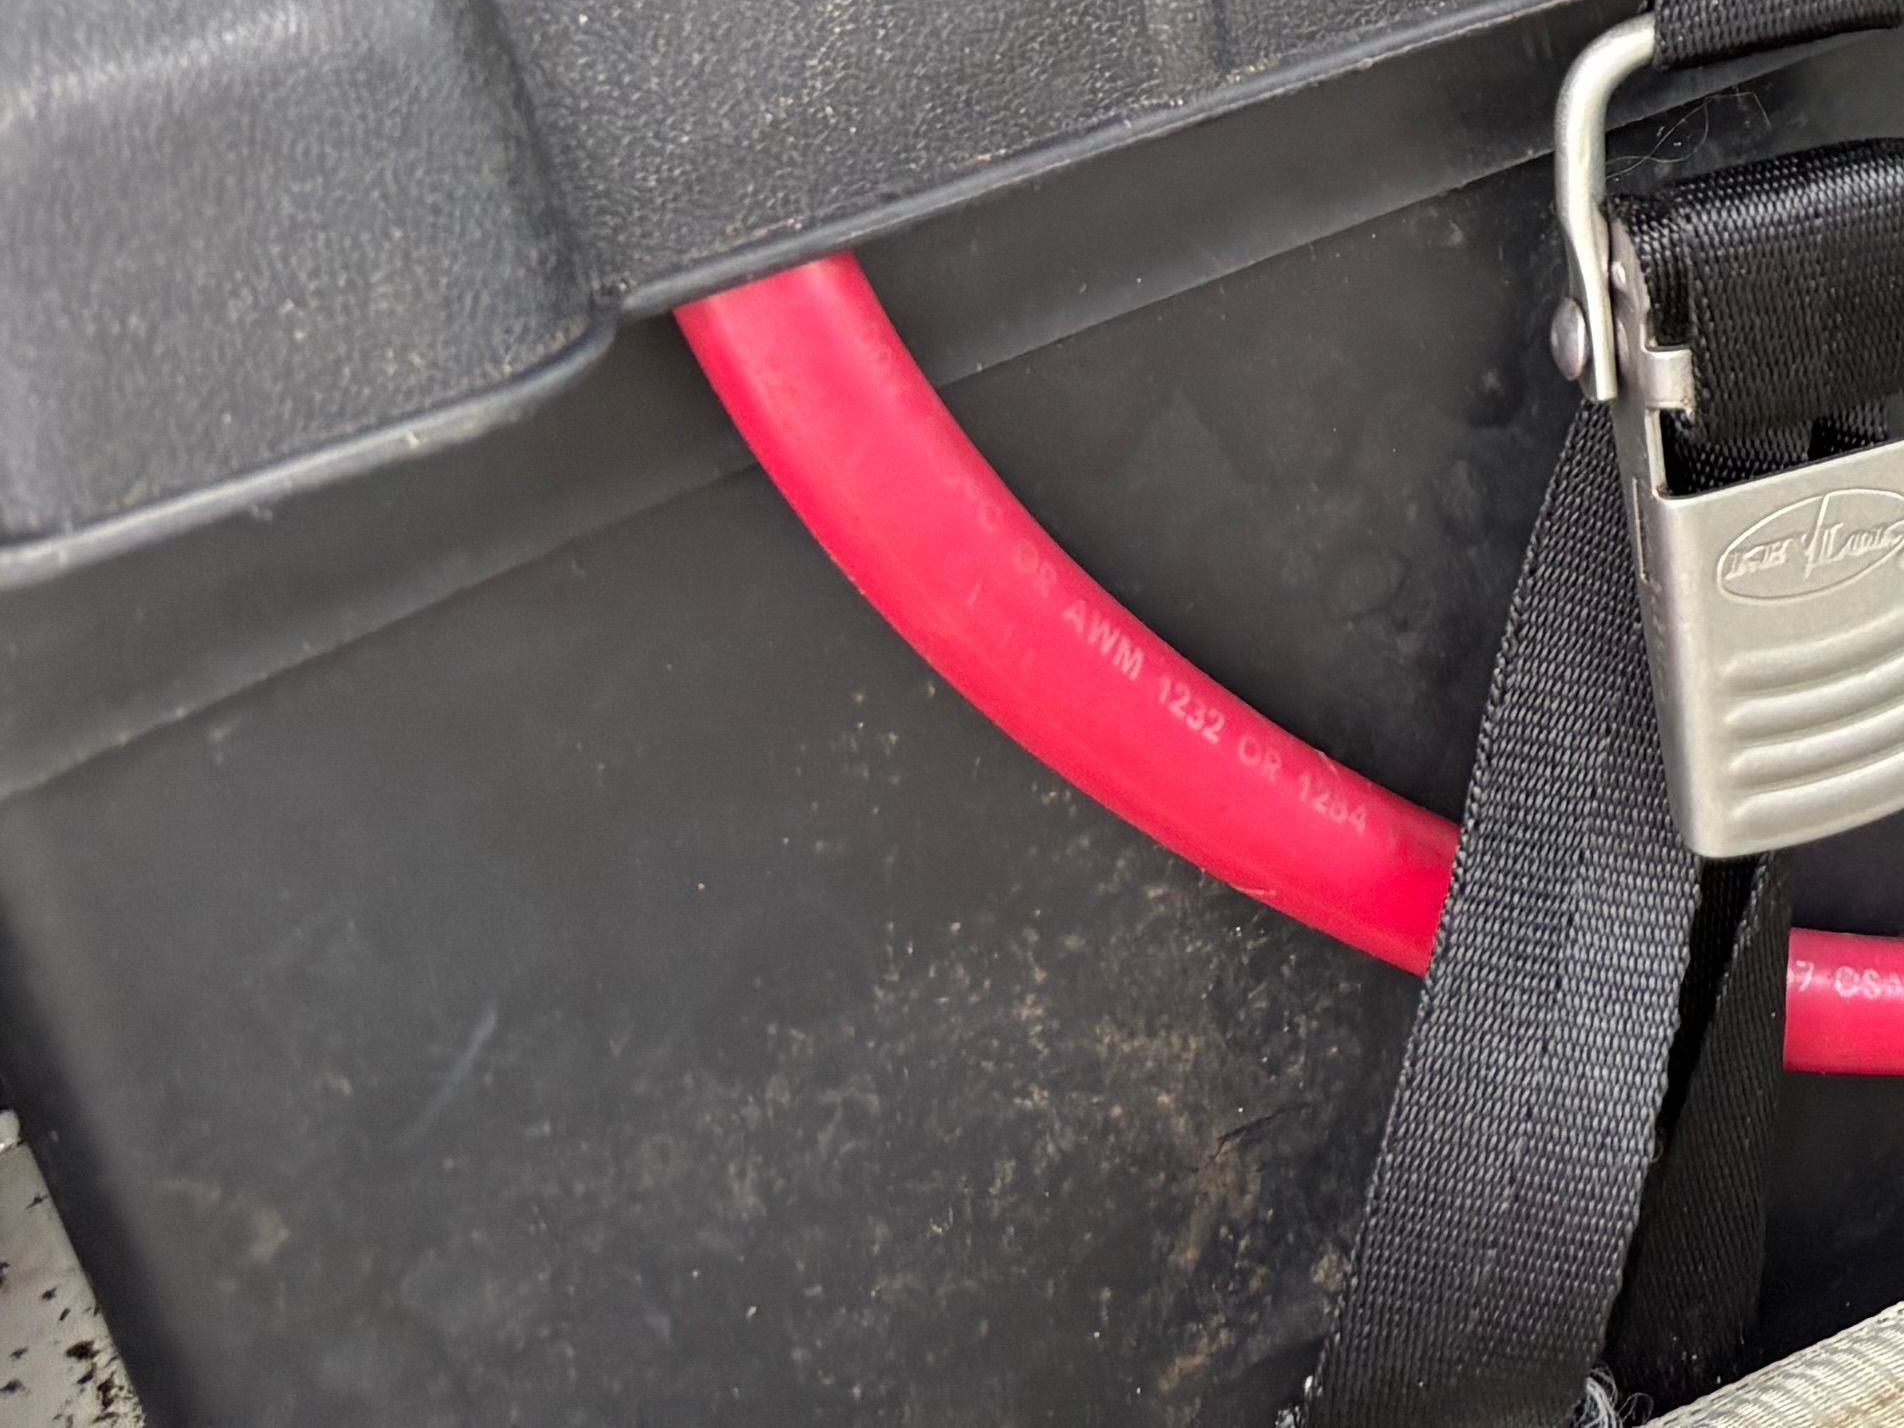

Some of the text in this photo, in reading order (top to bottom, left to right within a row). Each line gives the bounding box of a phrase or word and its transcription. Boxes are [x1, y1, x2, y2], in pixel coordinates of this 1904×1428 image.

[1063, 600, 1145, 681] AWM
[1157, 678, 1225, 745] 1232
[1237, 736, 1282, 783] OR
